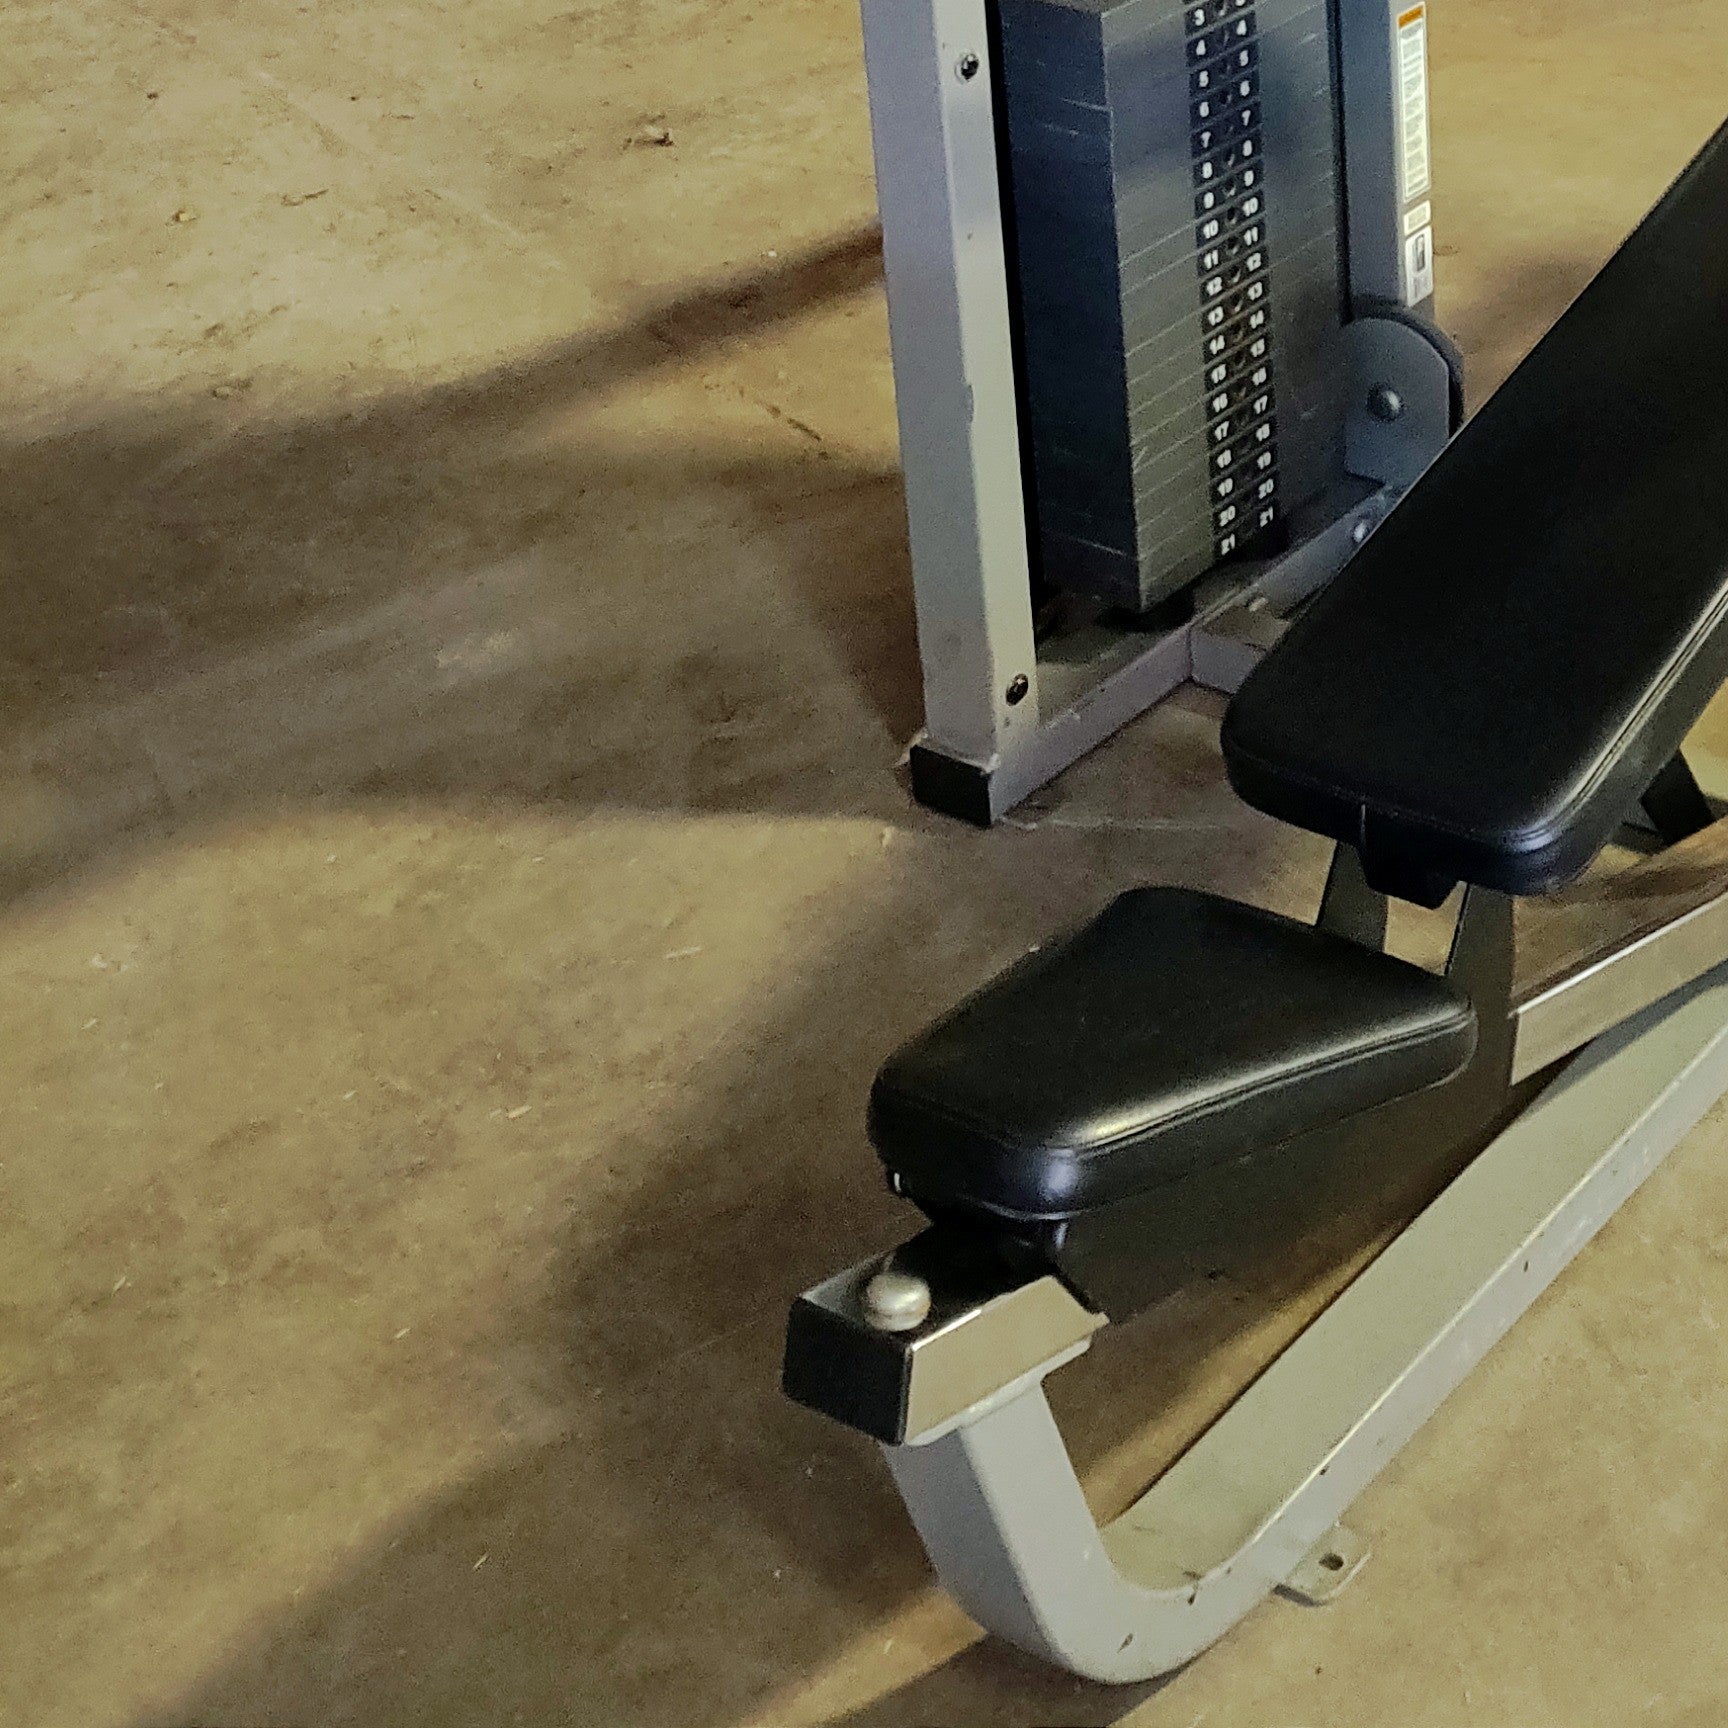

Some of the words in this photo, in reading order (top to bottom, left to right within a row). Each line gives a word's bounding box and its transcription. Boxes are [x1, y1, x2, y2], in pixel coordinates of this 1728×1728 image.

[1194, 8, 1205, 26] 3
[1196, 39, 1206, 56] 4
[1236, 19, 1247, 36] 4
[1201, 131, 1211, 148] 7
[1242, 110, 1251, 127] 7
[1202, 219, 1219, 239] 10
[1242, 197, 1258, 217] 10
[1203, 249, 1219, 269] 11
[1243, 226, 1258, 246] 11
[1214, 421, 1229, 441] 17
[1254, 395, 1268, 414] 17
